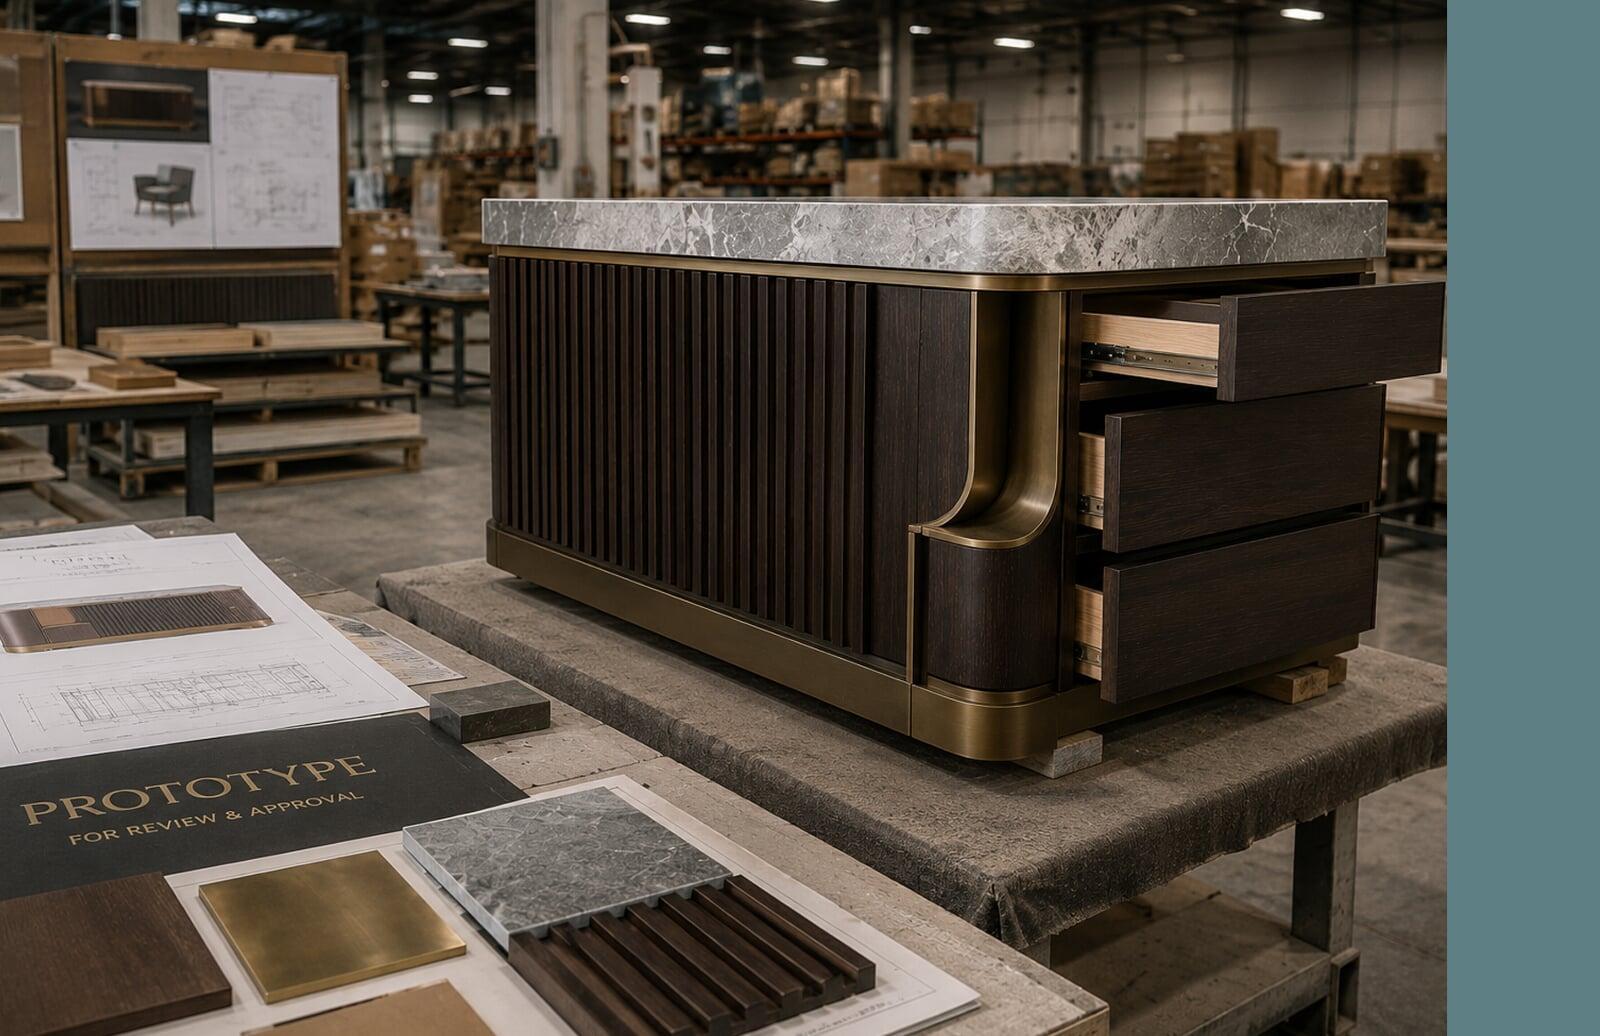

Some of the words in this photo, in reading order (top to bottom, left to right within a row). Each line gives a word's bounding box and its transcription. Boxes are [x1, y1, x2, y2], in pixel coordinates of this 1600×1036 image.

[20, 755, 377, 826] PROTOTYPE
[68, 829, 121, 847] FOR
[126, 811, 217, 837] REVIEW
[224, 809, 243, 822] &
[250, 790, 365, 817] APPROVAL
